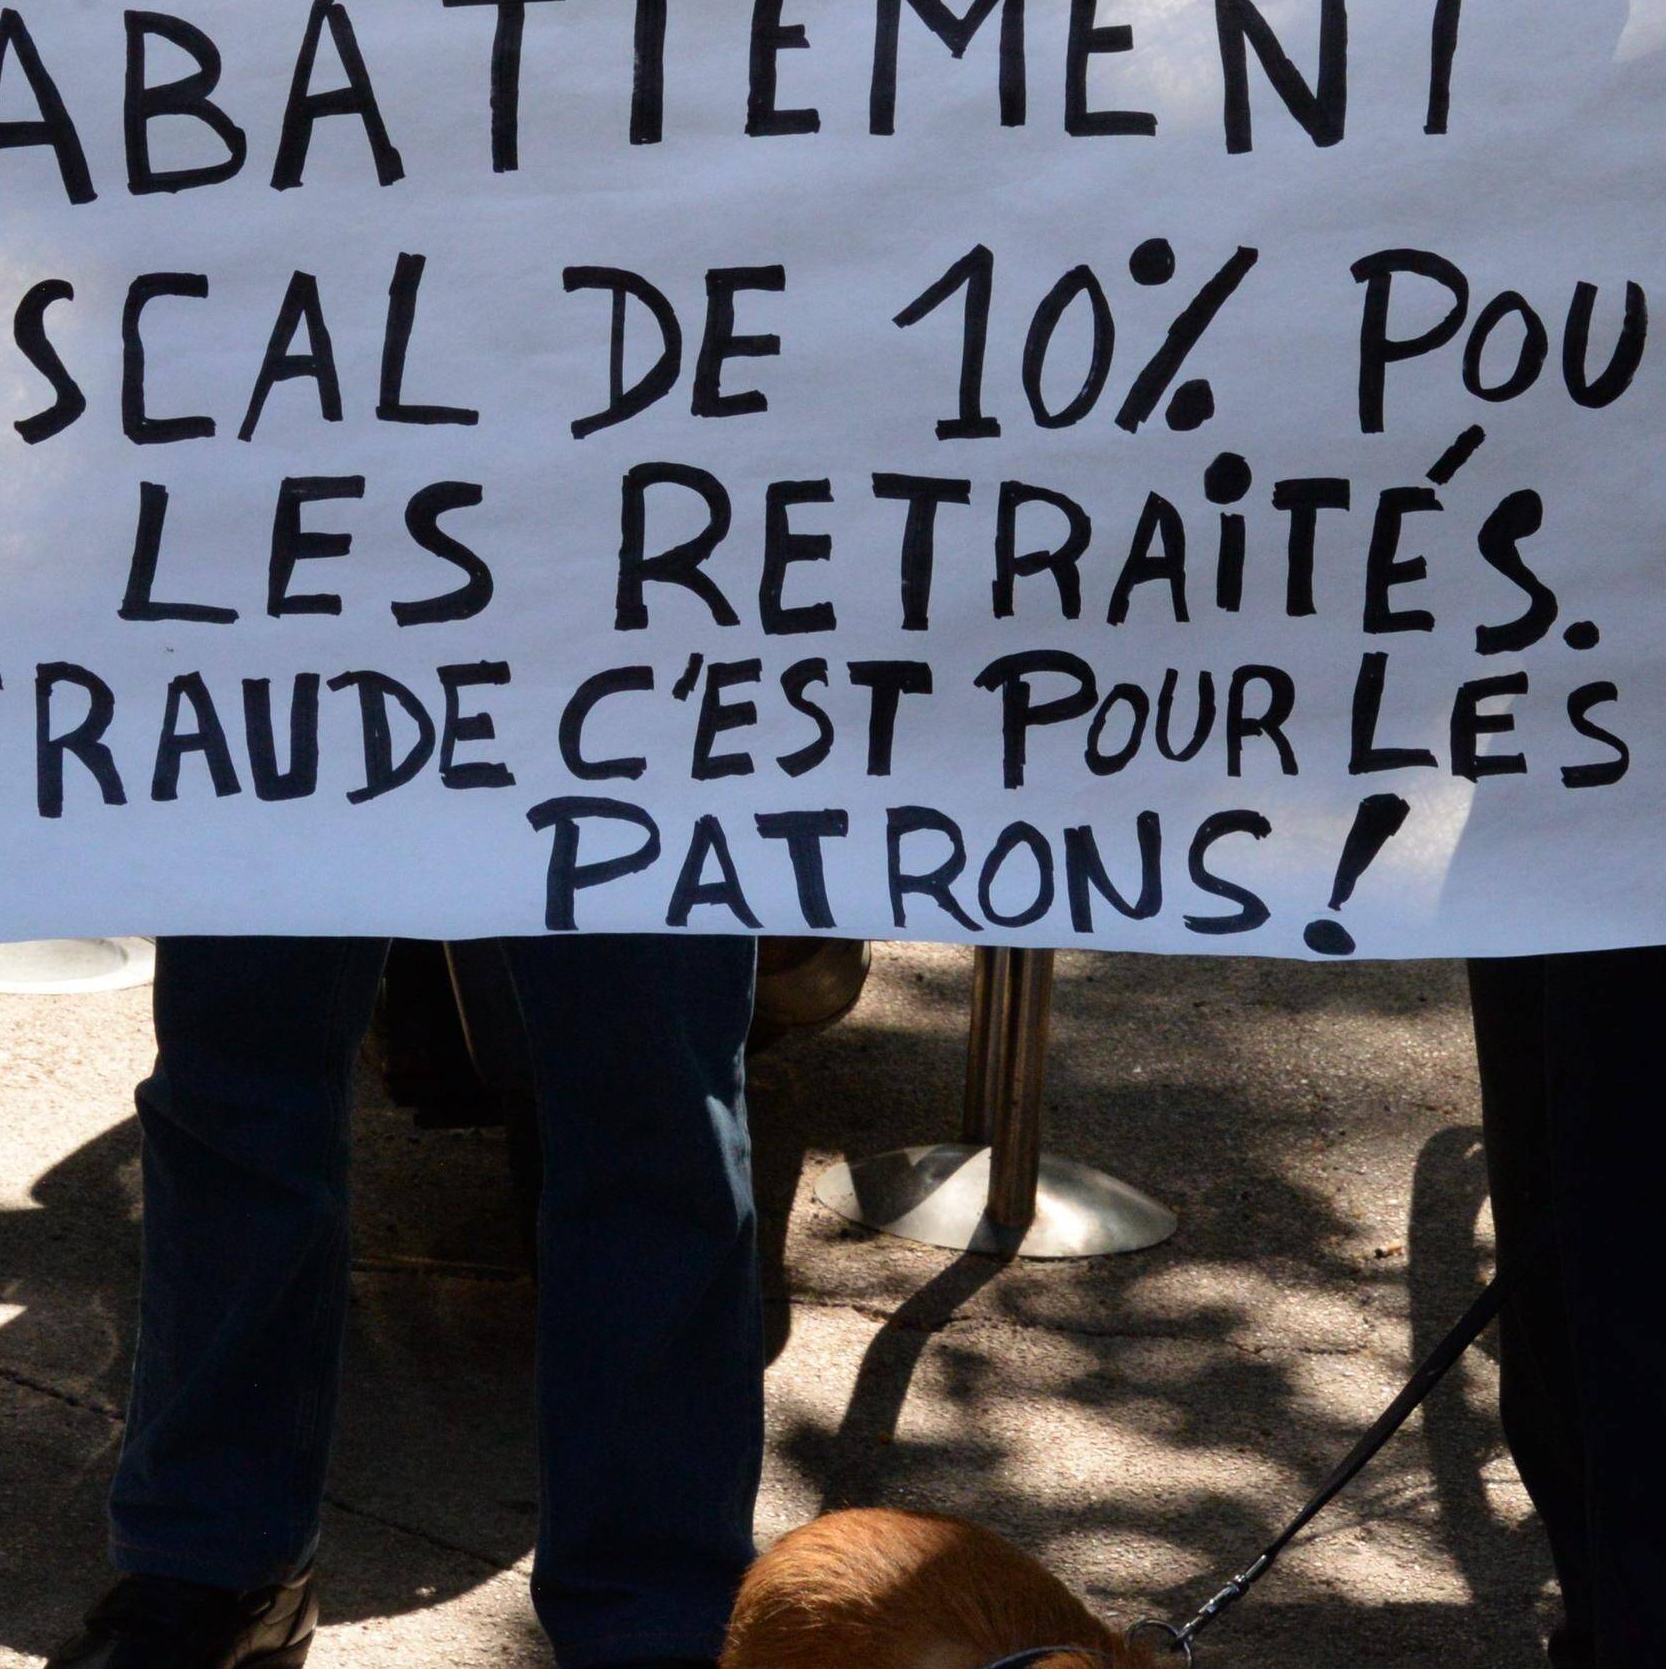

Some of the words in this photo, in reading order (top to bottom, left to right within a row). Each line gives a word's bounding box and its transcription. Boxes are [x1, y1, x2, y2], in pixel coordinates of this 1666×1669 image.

[562, 264, 787, 440] DE
[892, 237, 1259, 442] 10%
[117, 474, 494, 632] LES
[558, 652, 934, 782] C'EST
[972, 649, 1300, 790] POUR
[1347, 651, 1631, 789] LES
